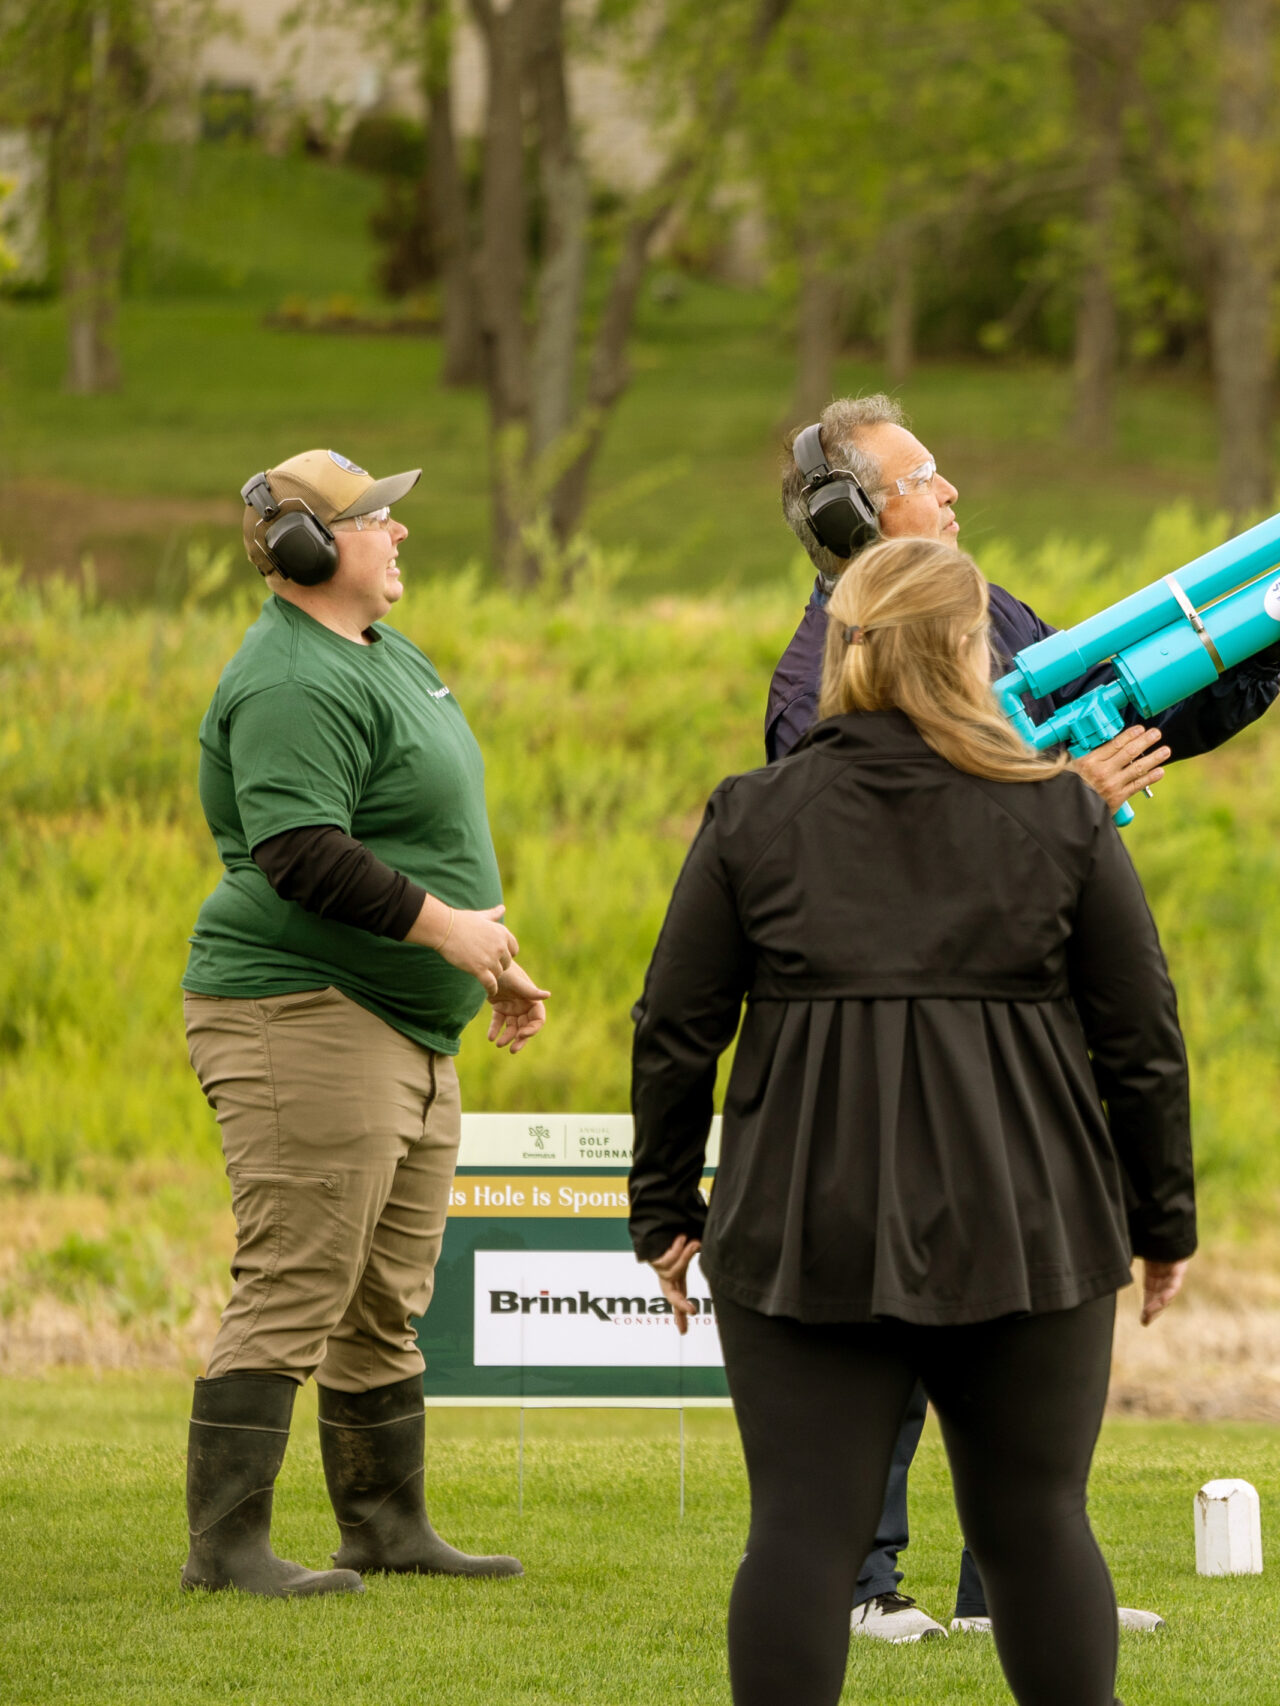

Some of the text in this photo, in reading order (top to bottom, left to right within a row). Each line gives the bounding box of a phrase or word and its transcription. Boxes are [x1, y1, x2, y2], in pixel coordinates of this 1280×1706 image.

[579, 1137, 610, 1146] GOLF
[474, 1185, 525, 1206] Hole
[532, 1187, 551, 1206] is
[558, 1187, 629, 1213] Spons
